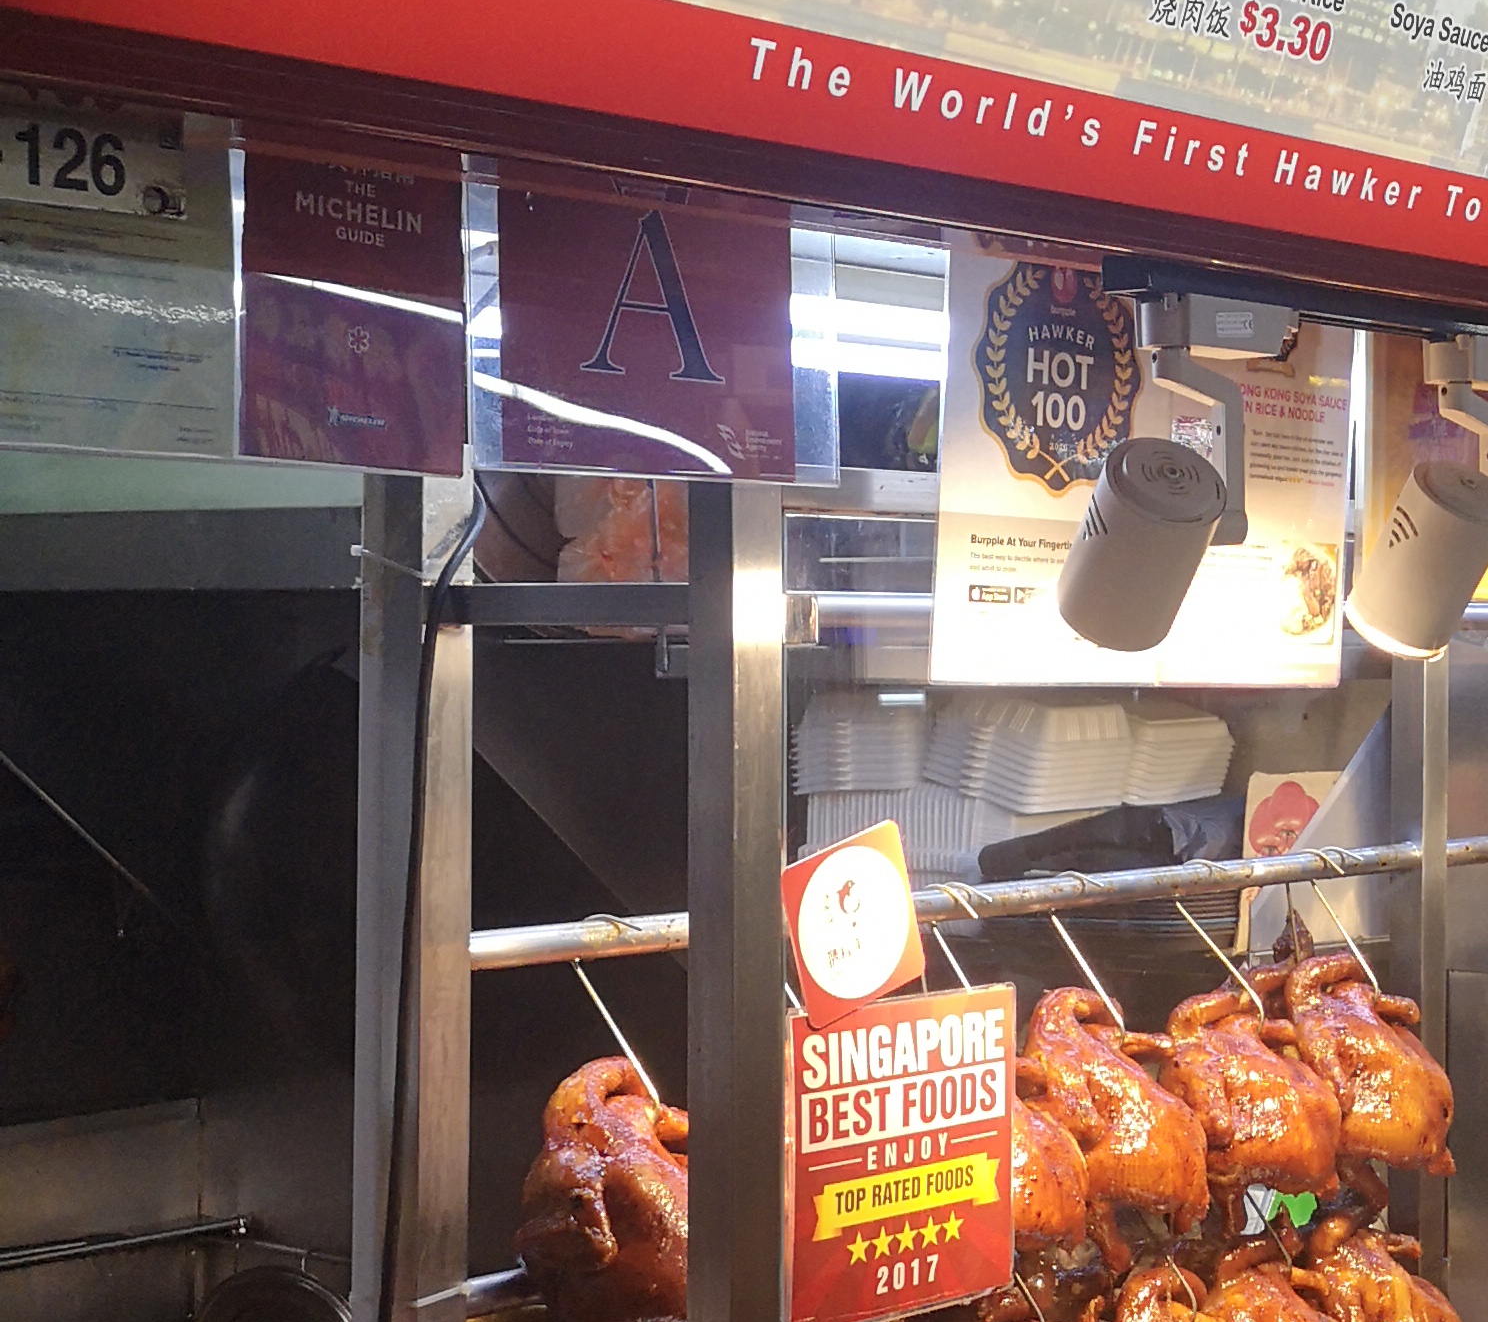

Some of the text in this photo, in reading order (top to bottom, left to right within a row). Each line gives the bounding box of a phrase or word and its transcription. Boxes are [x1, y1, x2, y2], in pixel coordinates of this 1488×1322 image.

[1239, 0, 1332, 62] $3.30
[1390, 2, 1435, 40] Soya
[1423, 60, 1487, 103] 油鸡面
[748, 36, 852, 98] The
[893, 68, 1102, 148] World's
[1132, 120, 1249, 177] First
[1274, 149, 1422, 210] Hawker
[1445, 184, 1481, 222] To
[345, 179, 377, 198] THE
[295, 190, 423, 235] MICHELIN
[336, 226, 386, 248] GUIDE
[579, 209, 726, 385] A
[1029, 324, 1094, 350] HAWKER
[1027, 348, 1094, 390] HOT
[1031, 391, 1086, 431] 100
[1240, 384, 1348, 410] ONG KONG SOYA SAUCE
[1255, 402, 1277, 416] RICE
[1279, 406, 1285, 417] &
[1288, 407, 1326, 424] NOODLE
[971, 534, 1004, 547] Burpple
[1007, 536, 1016, 546] At
[1019, 537, 1036, 547] Your
[802, 1008, 1005, 1089] SINGAPORE
[808, 1068, 997, 1144] BEST FOODS
[867, 1132, 949, 1171] ENJOY
[836, 1165, 975, 1216] TOP RATED FOODS
[876, 1254, 939, 1296] 2017
